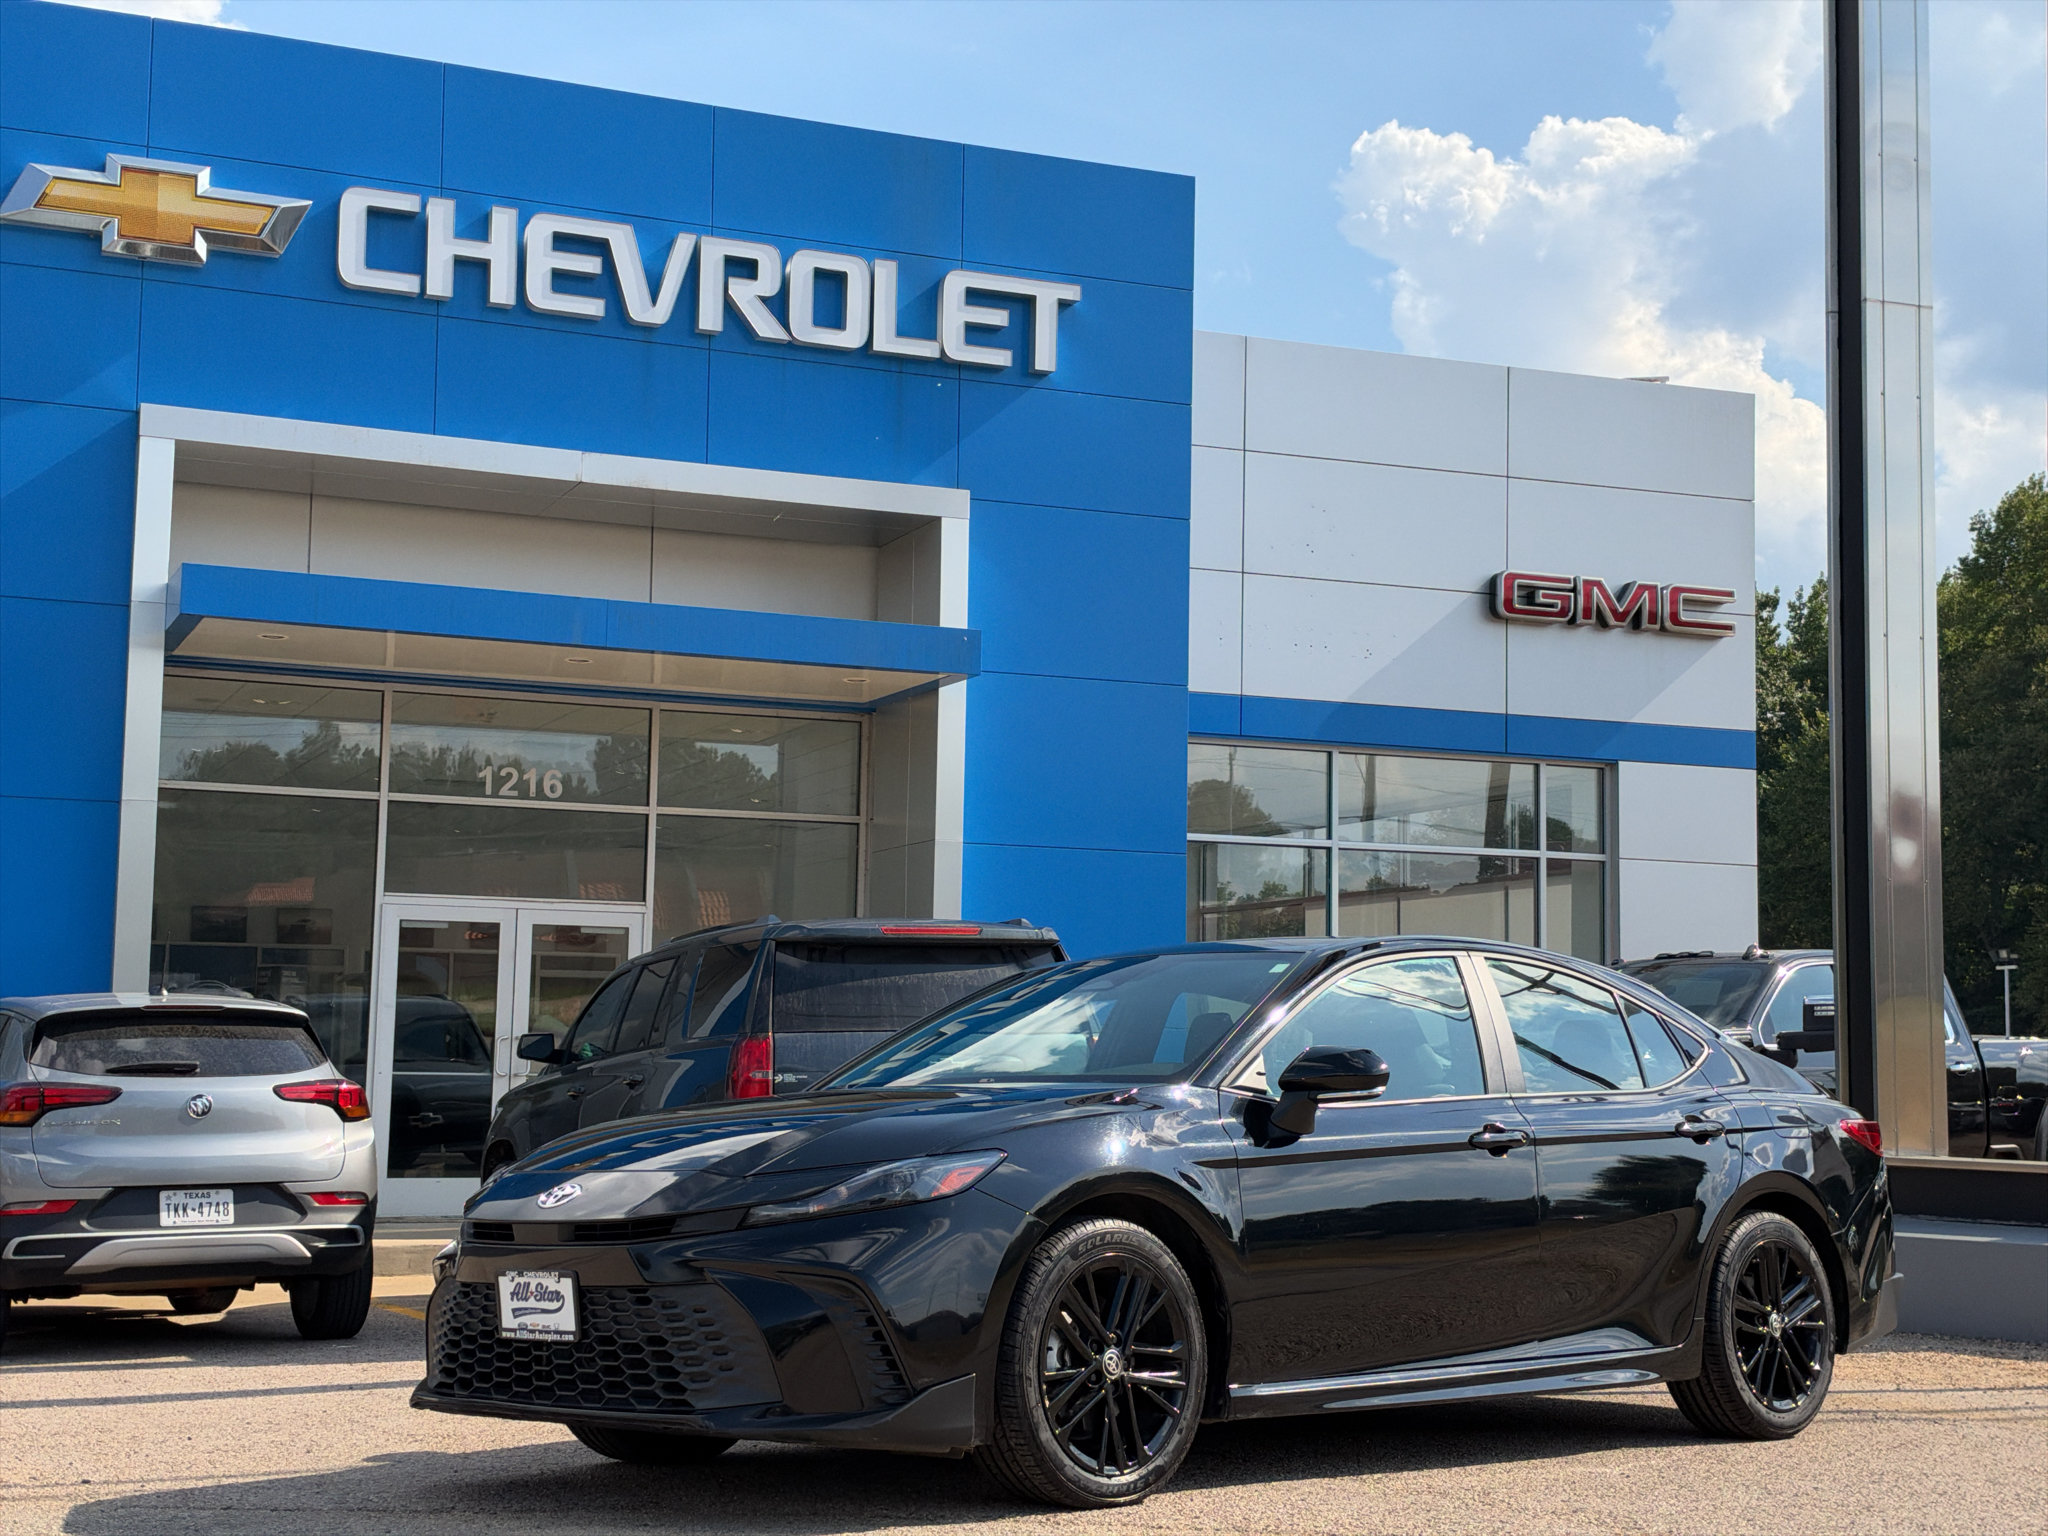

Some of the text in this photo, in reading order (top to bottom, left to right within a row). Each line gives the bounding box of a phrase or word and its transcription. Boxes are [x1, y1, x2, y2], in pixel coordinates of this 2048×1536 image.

[337, 186, 1082, 374] CHEVROLET
[1490, 570, 1736, 637] GMC
[478, 766, 563, 799] 1216
